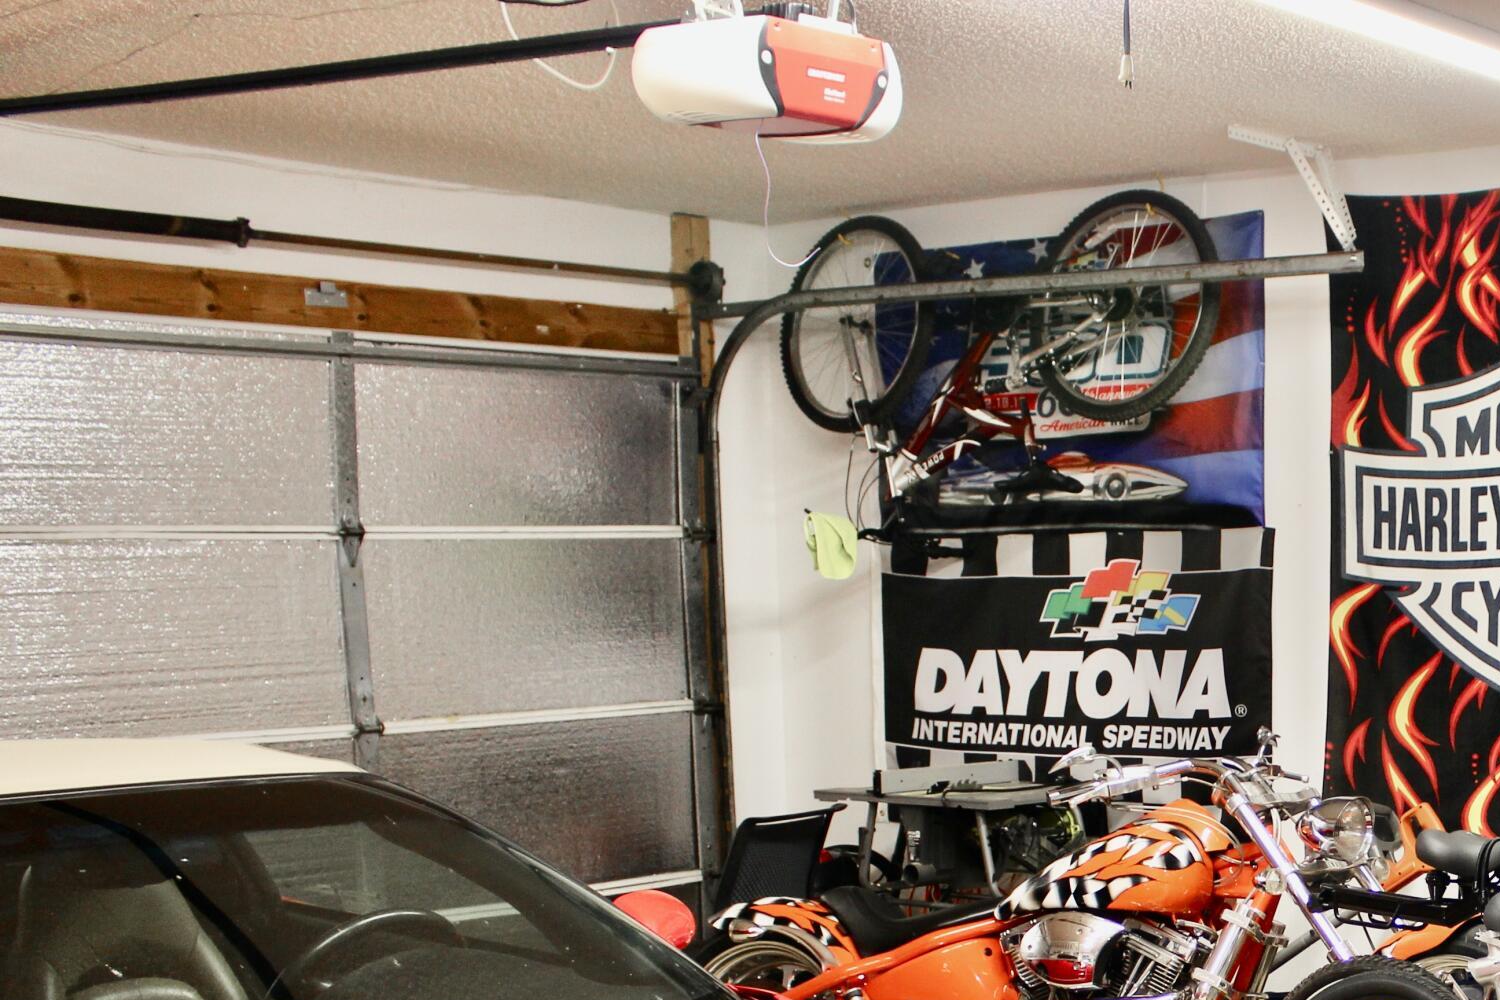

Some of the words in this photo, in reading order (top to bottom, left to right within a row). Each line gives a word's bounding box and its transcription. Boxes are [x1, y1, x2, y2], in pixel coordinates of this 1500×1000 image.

[914, 647, 1232, 719] DAYTONA
[912, 717, 1096, 749] INTERNATIONAL
[1102, 724, 1232, 750] SPEEDWAY
